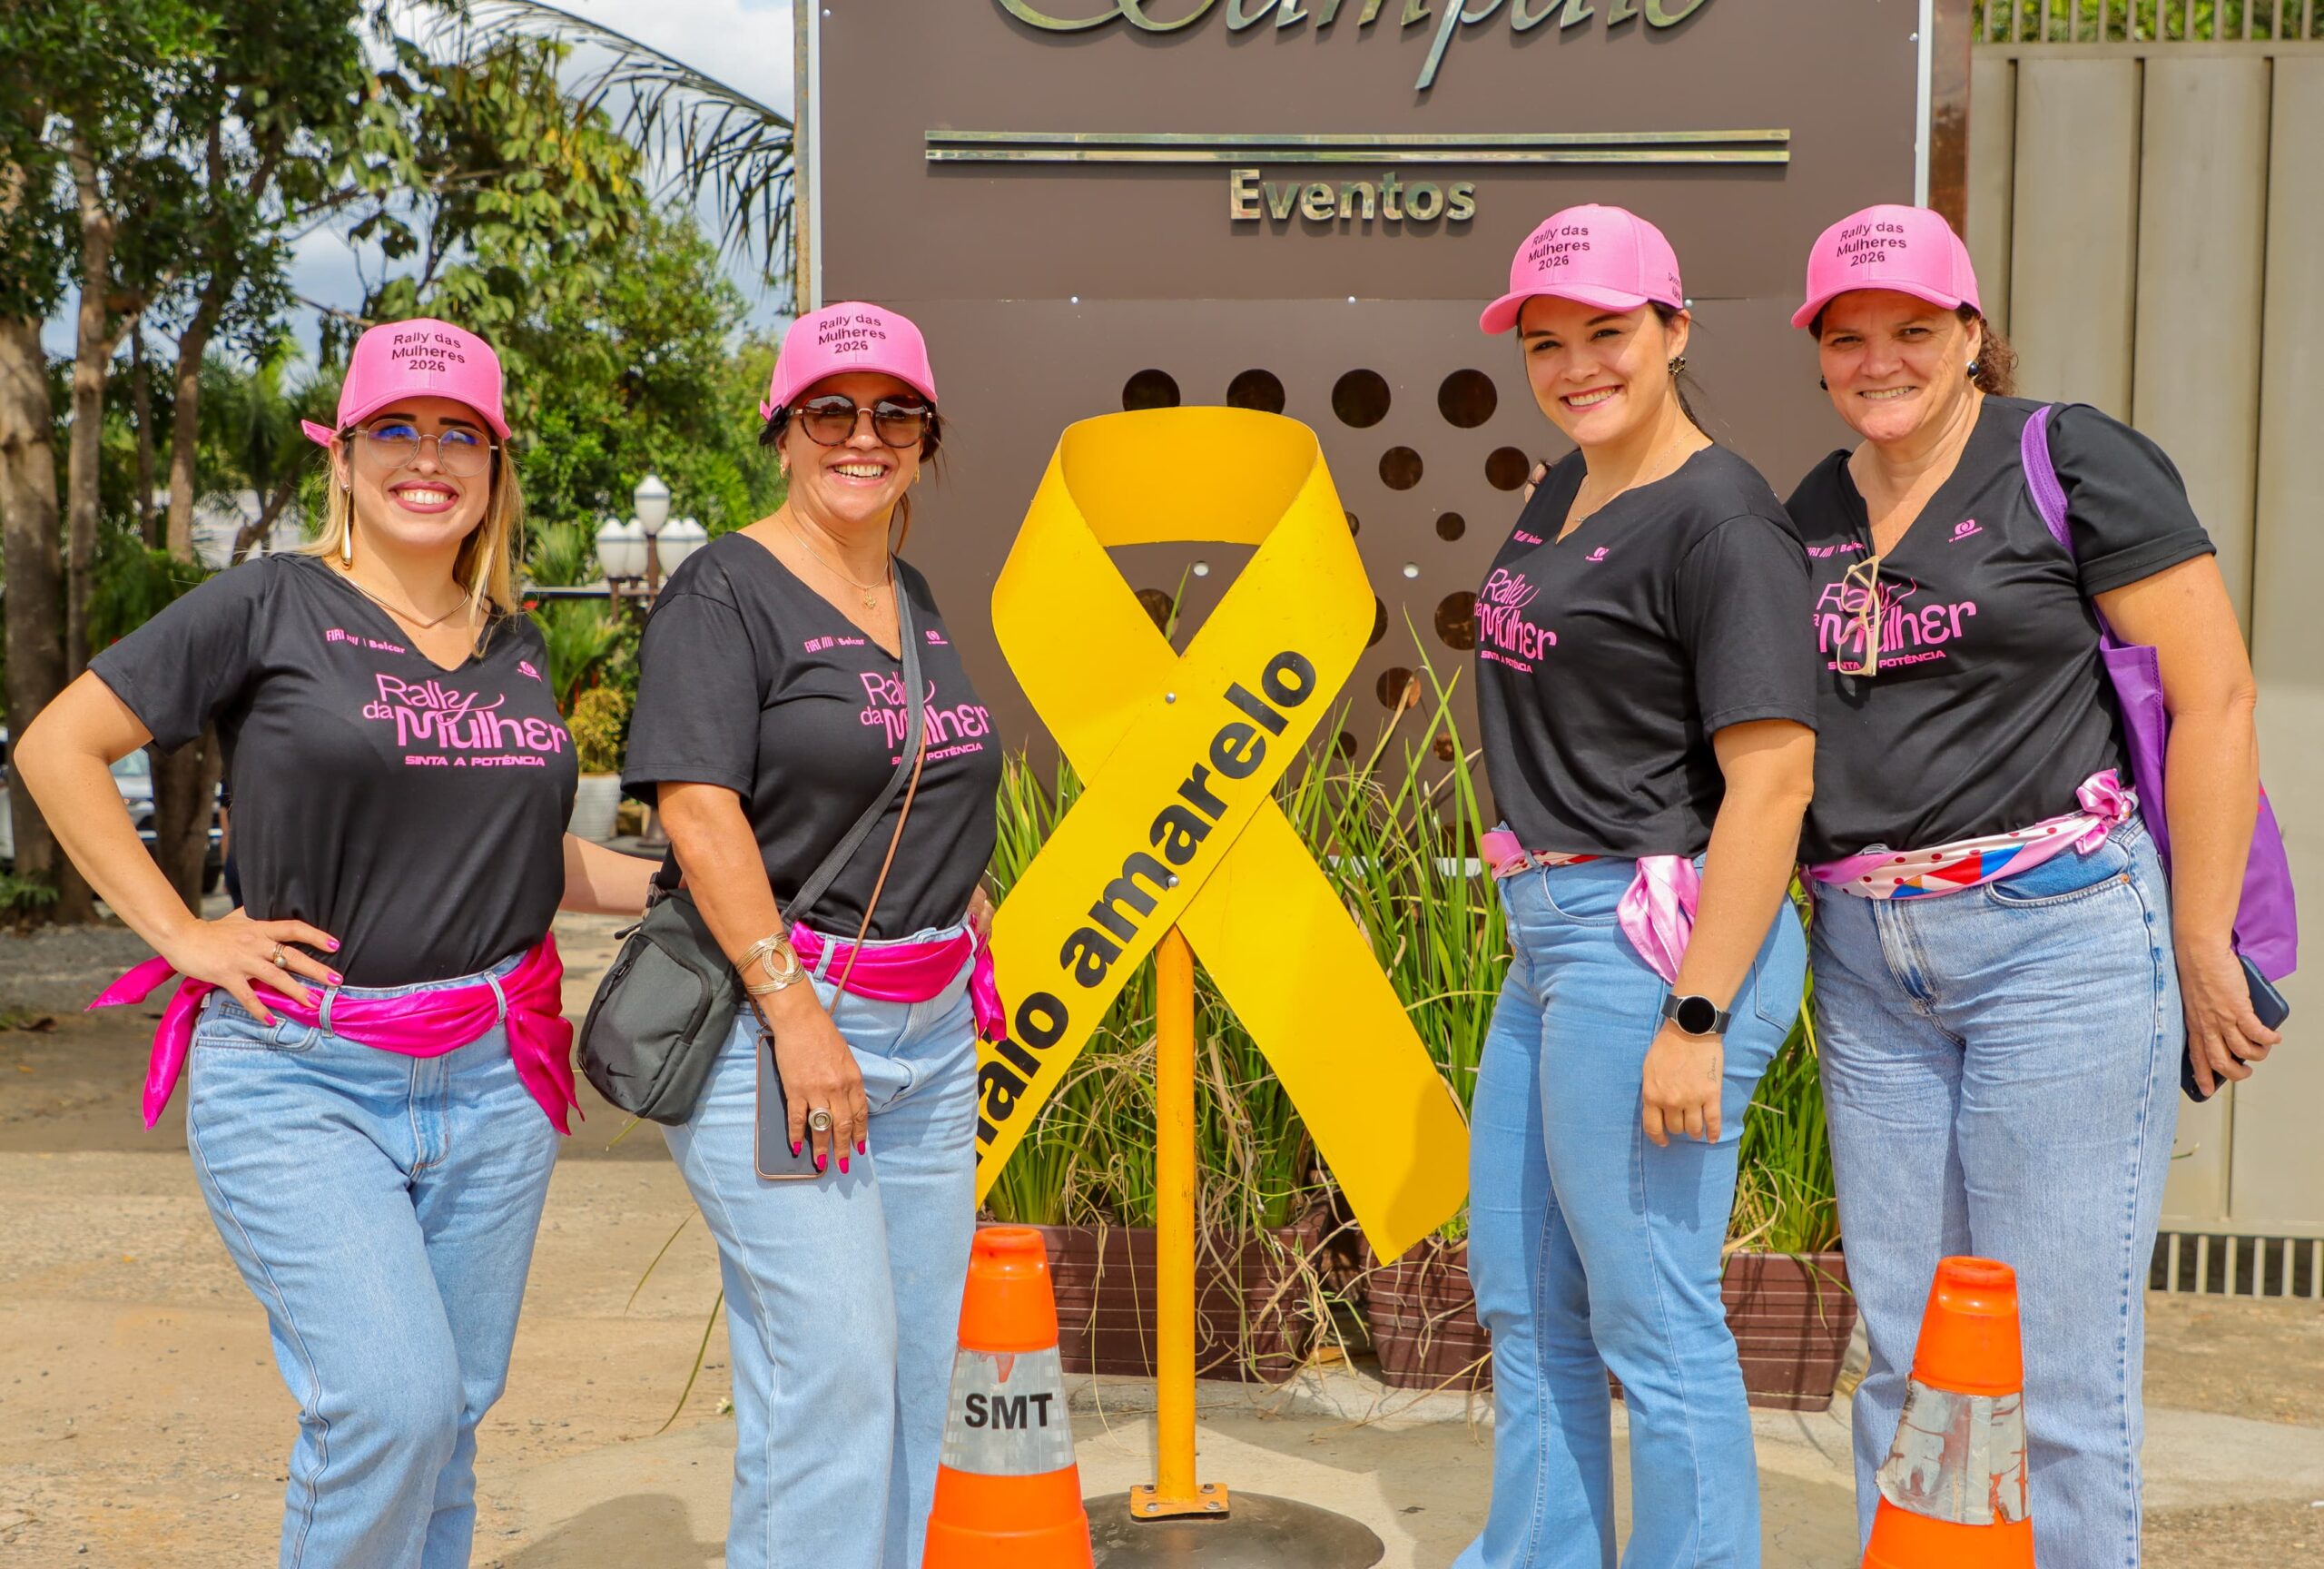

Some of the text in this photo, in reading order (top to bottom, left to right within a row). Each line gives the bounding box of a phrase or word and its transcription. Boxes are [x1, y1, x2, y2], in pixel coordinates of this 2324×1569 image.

[1230, 168, 1476, 221] Eventos
[1531, 224, 1589, 247] Rally das
[1839, 221, 1904, 242] Rally das
[1528, 240, 1590, 263] Mulheres
[1837, 237, 1907, 258] Mulheres
[1538, 254, 1570, 271] 2026
[1850, 251, 1886, 267] 2026
[819, 313, 881, 332] Rally das
[393, 331, 461, 349] Rally das
[818, 328, 886, 345] Mulheres
[391, 345, 465, 364] Mulheres
[834, 340, 869, 354] 2026
[408, 359, 446, 372] 2026
[1482, 568, 1541, 624] Rally
[369, 639, 406, 654] Belcar
[1878, 651, 1946, 668] POTÊNCIA
[375, 674, 505, 725] Rally
[363, 700, 395, 719] da
[861, 706, 884, 725] da
[405, 755, 546, 767] SINTA A POTÊNCIA
[926, 743, 983, 761] POTÊNCIA
[975, 650, 1316, 1169] aio amarelo
[963, 1392, 1053, 1430] SMT
